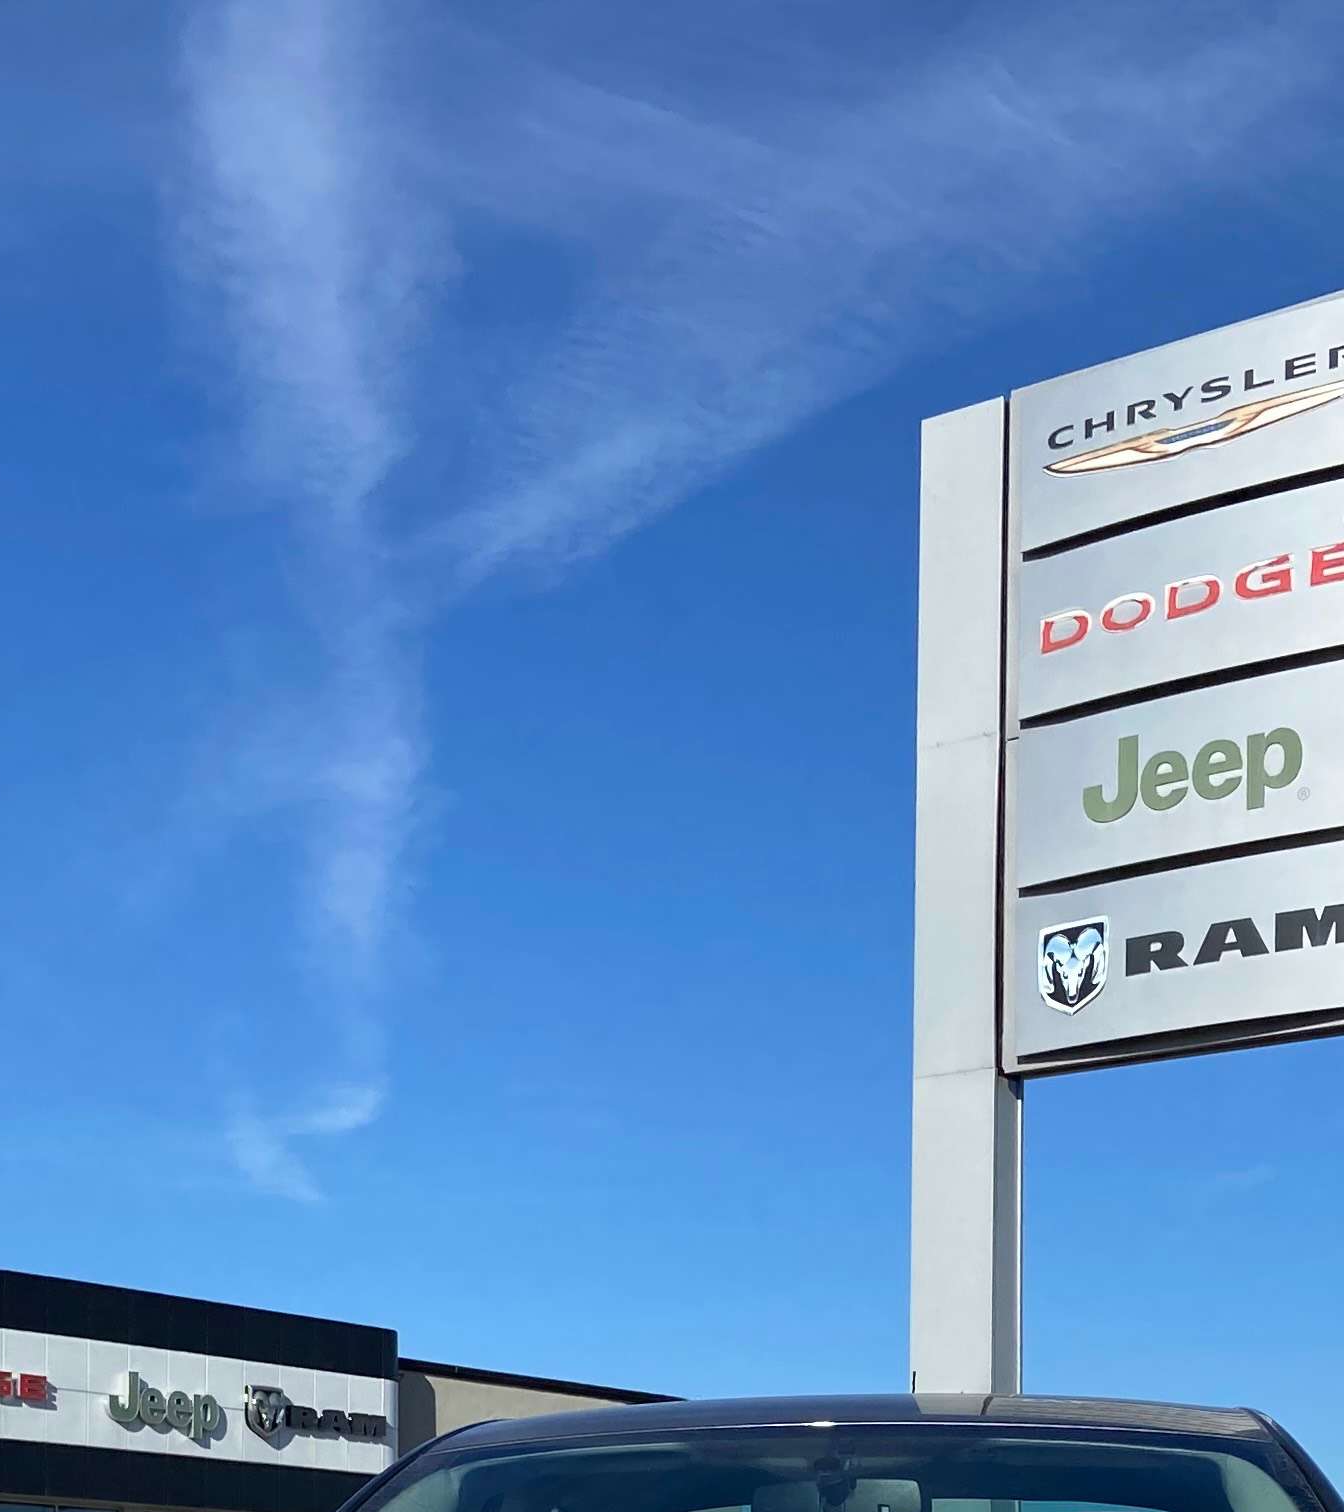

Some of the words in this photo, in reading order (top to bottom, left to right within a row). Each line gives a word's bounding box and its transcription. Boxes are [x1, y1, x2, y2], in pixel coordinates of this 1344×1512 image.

[1082, 727, 1303, 824] Jeep
[109, 1371, 220, 1439] Jeep
[285, 1405, 387, 1438] RAM
